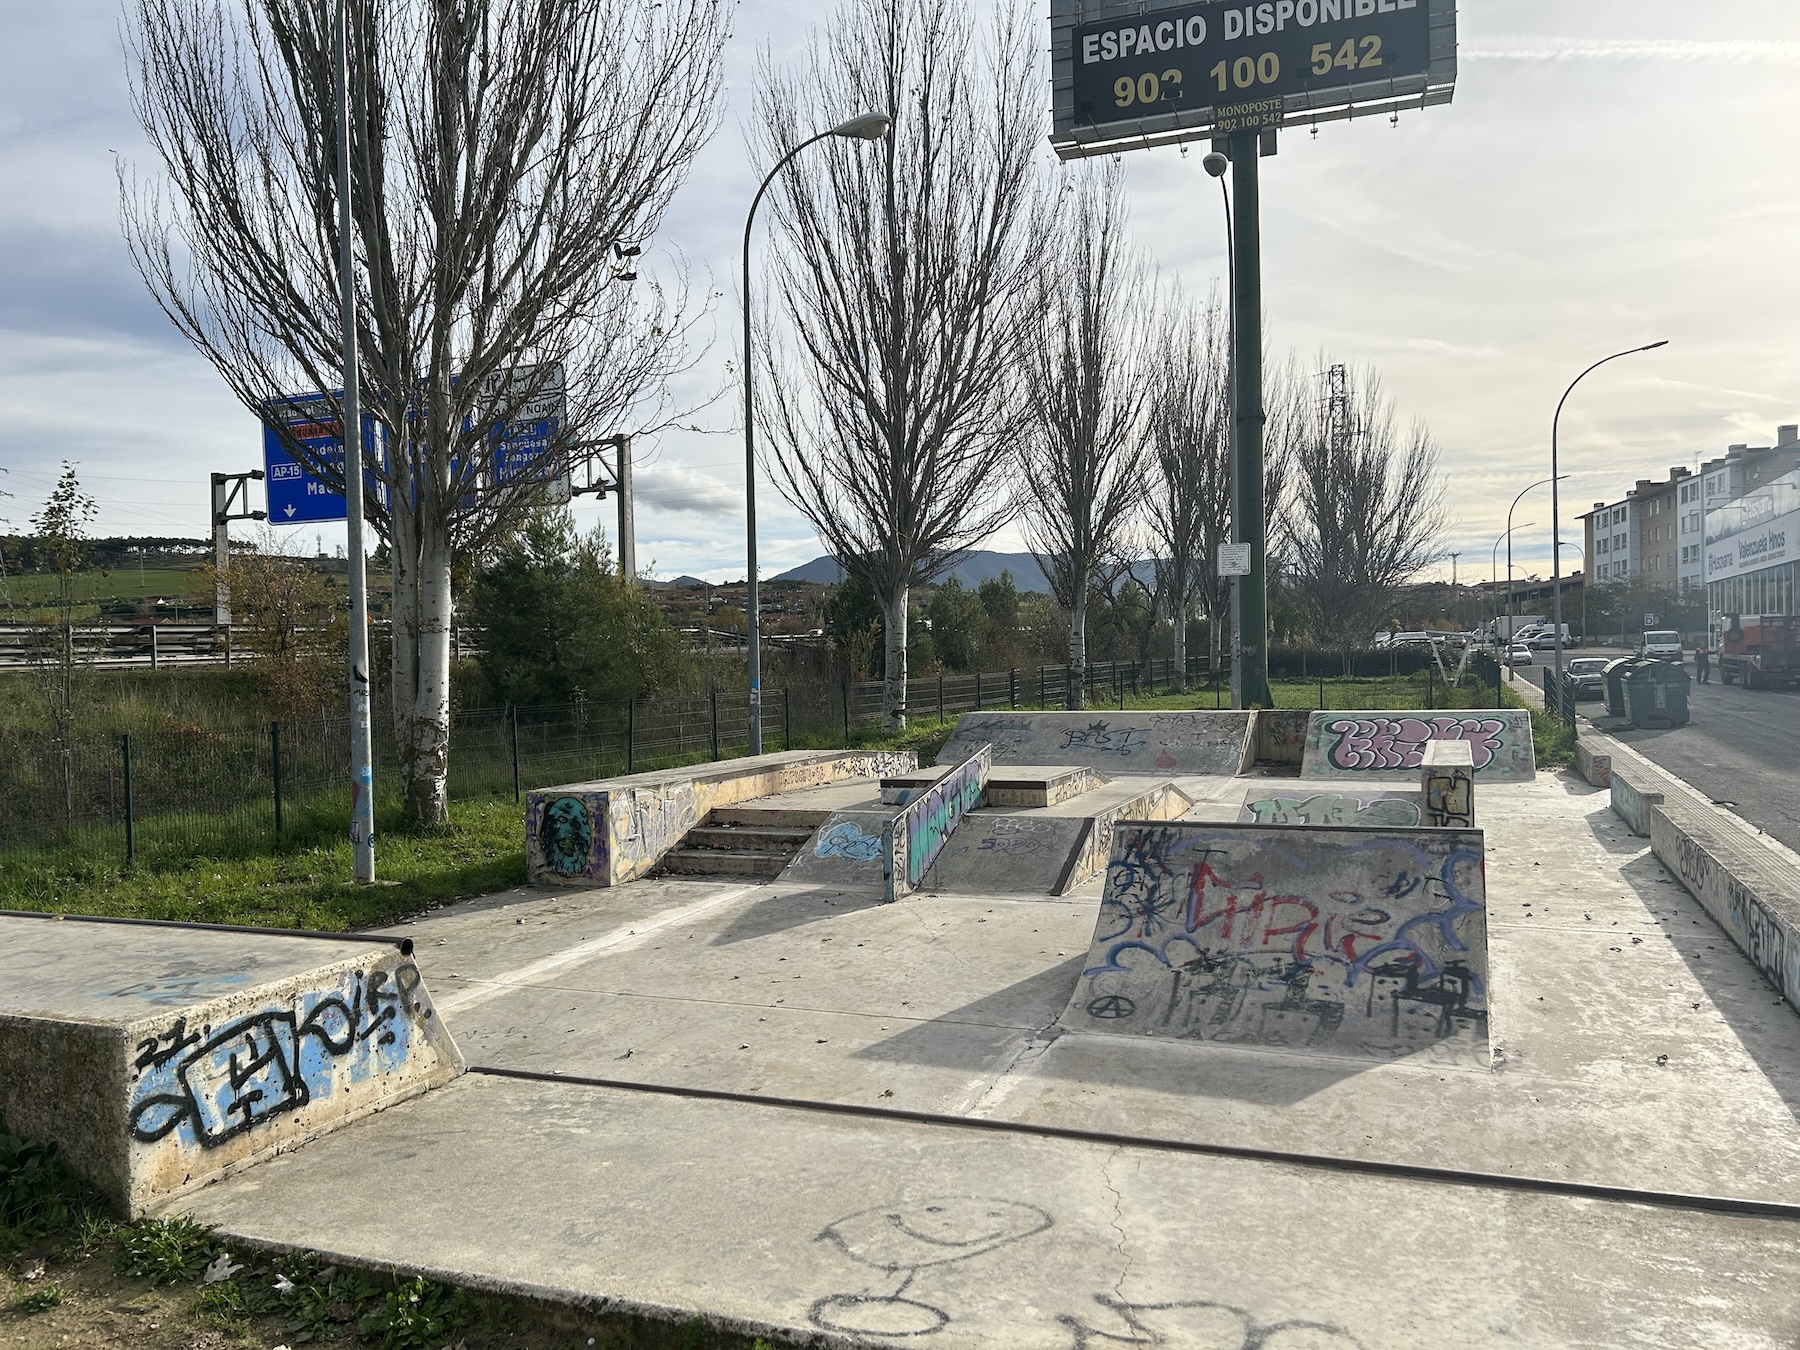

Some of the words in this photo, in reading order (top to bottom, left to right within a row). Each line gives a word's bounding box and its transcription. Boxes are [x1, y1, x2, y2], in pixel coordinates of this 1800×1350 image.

[1082, 15, 1207, 64] ESPACIO
[1113, 68, 1183, 107] 902
[1210, 52, 1280, 92] 100
[1311, 35, 1382, 76] 542
[1217, 98, 1282, 118] MONOPOSTE
[1218, 118, 1237, 131] 902
[1240, 115, 1260, 128] 100
[1262, 111, 1281, 125] 542
[273, 464, 300, 478] AP-15
[1738, 533, 1768, 559] Valenzuela
[1768, 528, 1786, 551] Hnos
